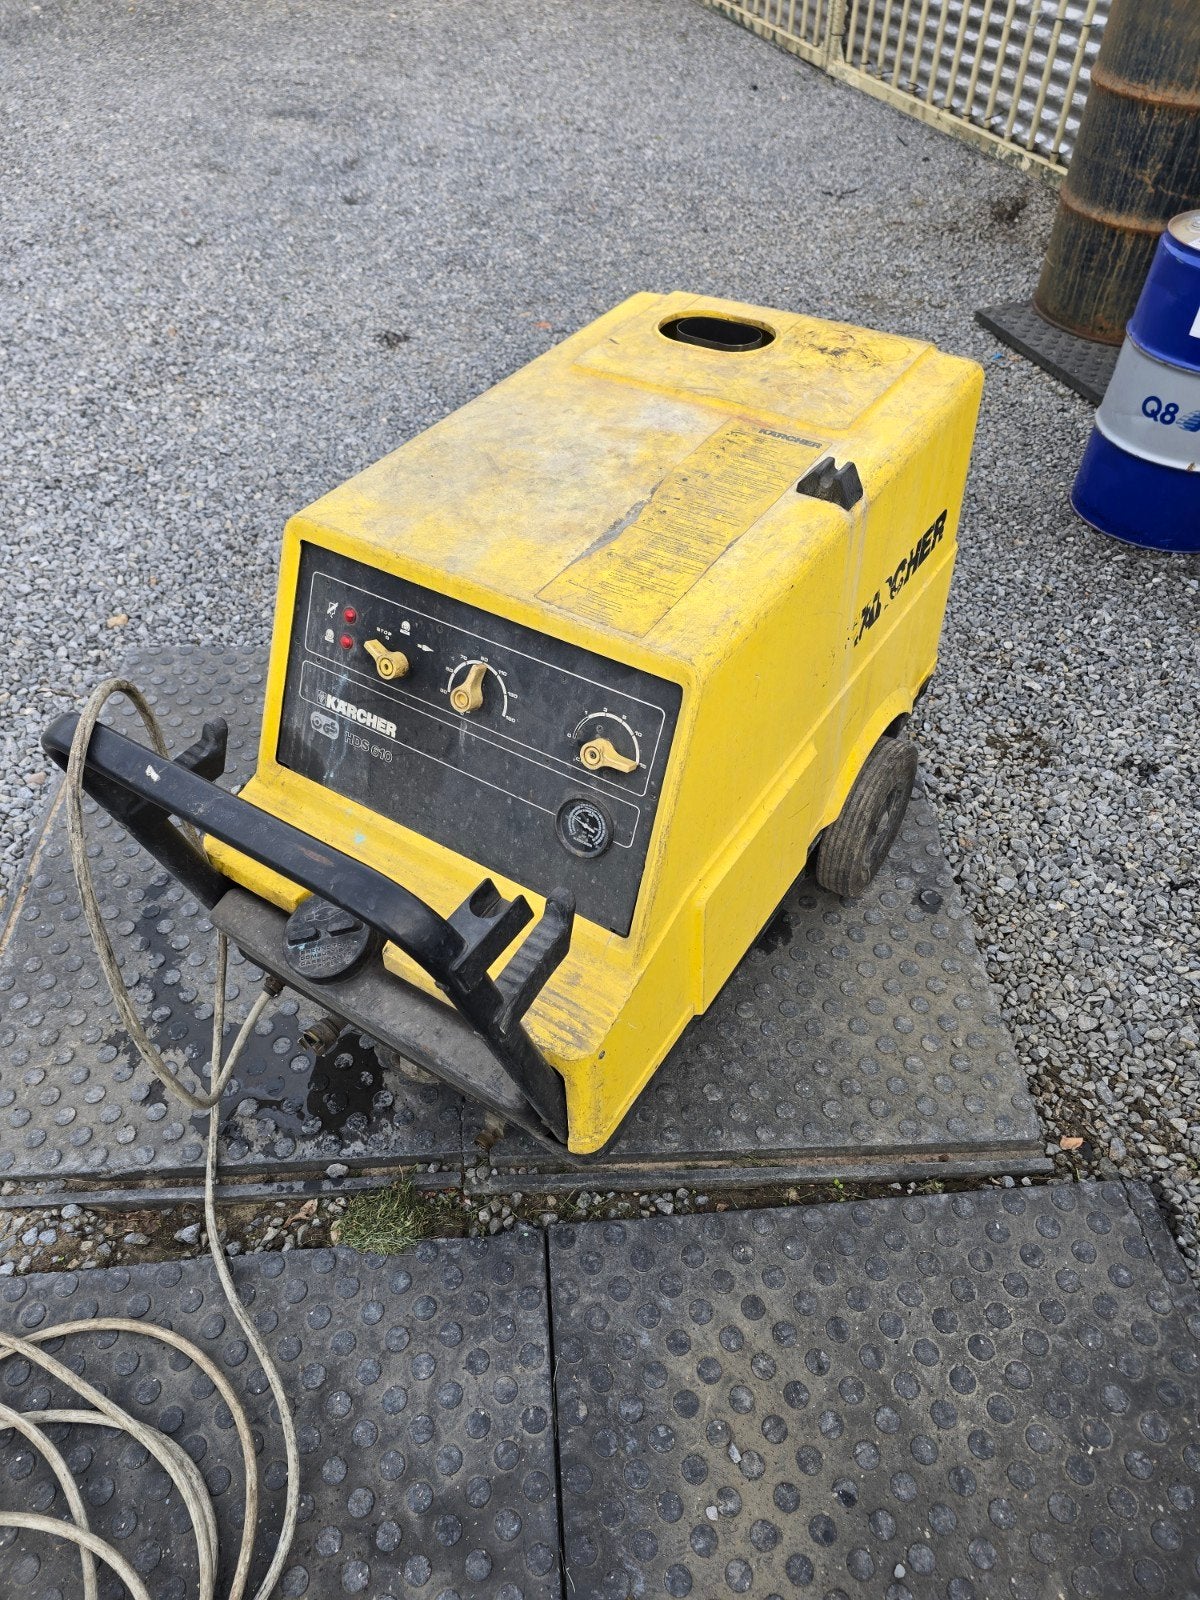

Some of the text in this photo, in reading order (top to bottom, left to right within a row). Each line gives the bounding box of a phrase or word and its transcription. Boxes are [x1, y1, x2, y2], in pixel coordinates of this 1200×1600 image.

[1142, 396, 1179, 425] Q8
[345, 730, 393, 763] HDS 610
